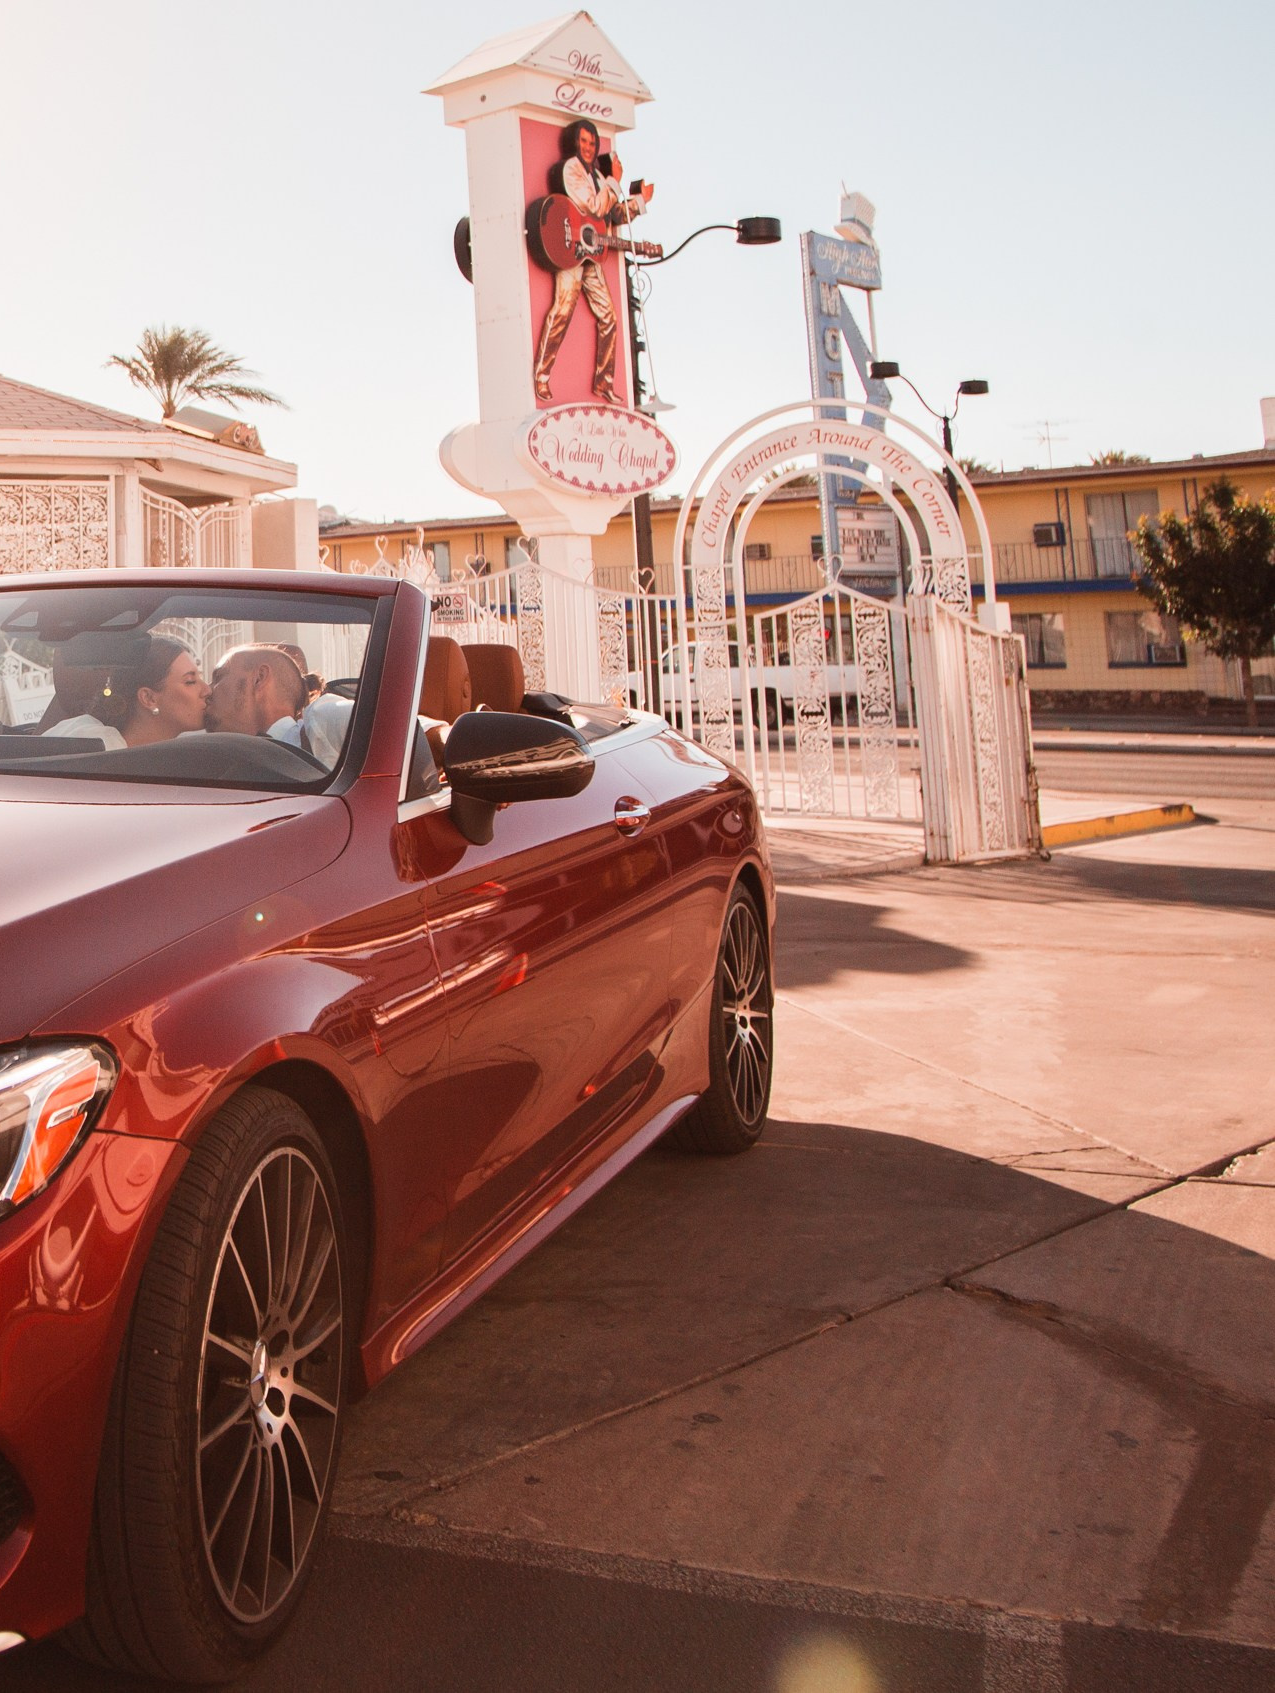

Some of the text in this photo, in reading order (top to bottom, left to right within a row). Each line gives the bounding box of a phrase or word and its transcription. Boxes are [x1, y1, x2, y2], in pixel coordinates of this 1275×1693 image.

[568, 49, 602, 76] With
[551, 82, 613, 118] Love
[541, 433, 659, 476] Wedding Chapel
[702, 428, 952, 548] Chapel Entrance Around The Corner
[437, 596, 451, 607] NO
